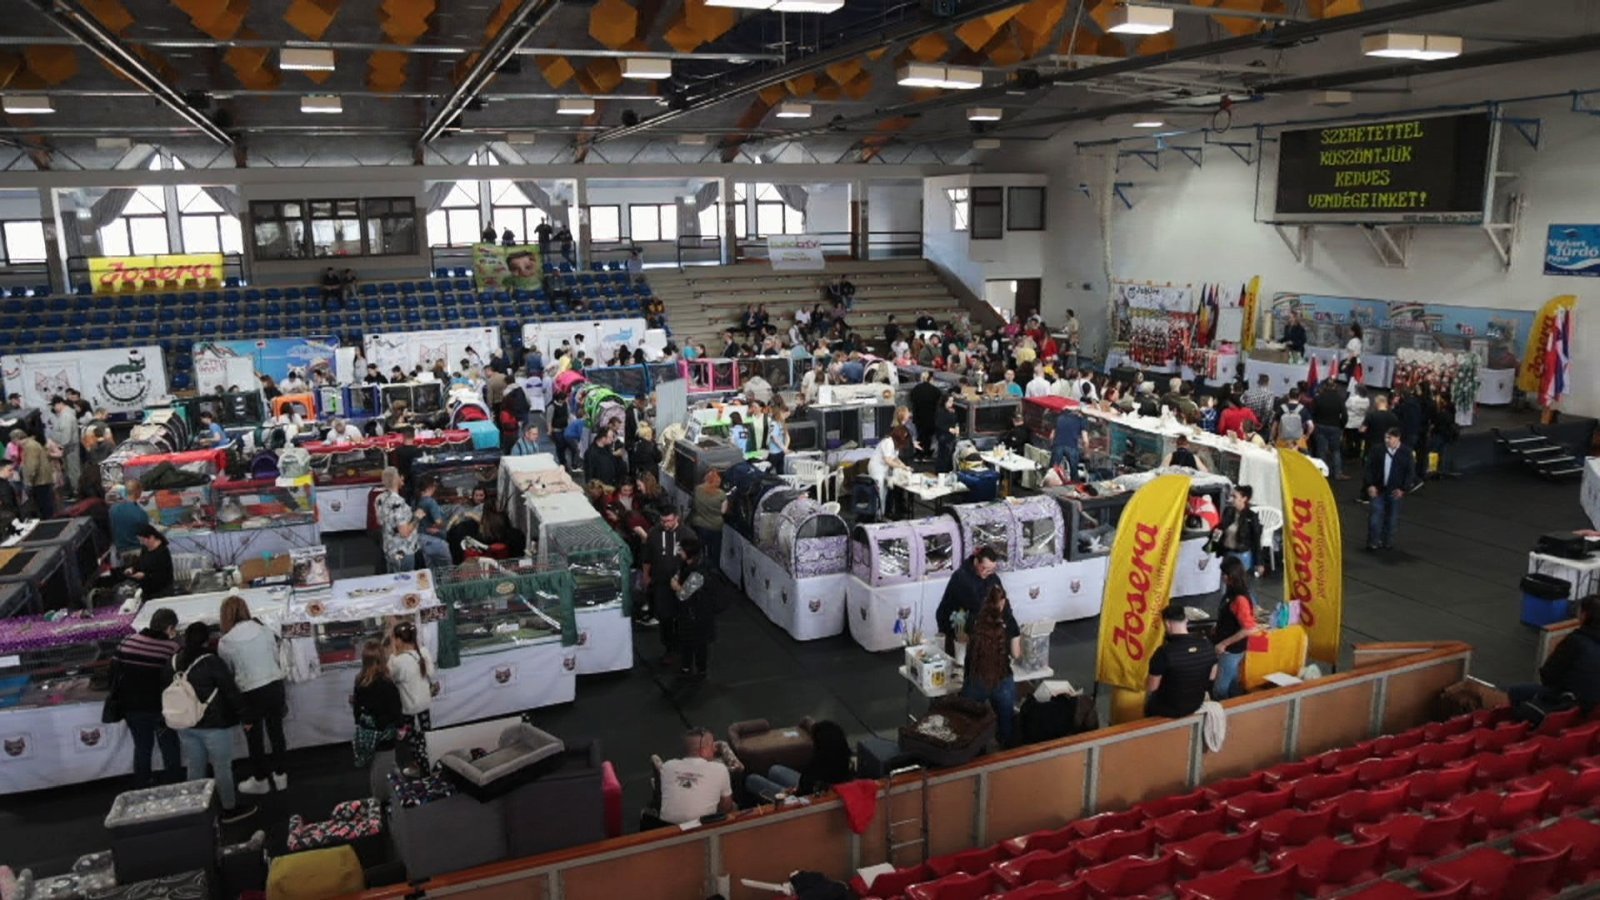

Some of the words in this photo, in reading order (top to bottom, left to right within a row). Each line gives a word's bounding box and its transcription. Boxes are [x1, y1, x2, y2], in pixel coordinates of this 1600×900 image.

[1321, 121, 1424, 144] SZERETETTEL
[1334, 169, 1391, 187] KEDVES
[1308, 191, 1427, 208] VENDÉGEINKET!
[100, 262, 214, 284] Josera
[1113, 522, 1158, 661] Josera
